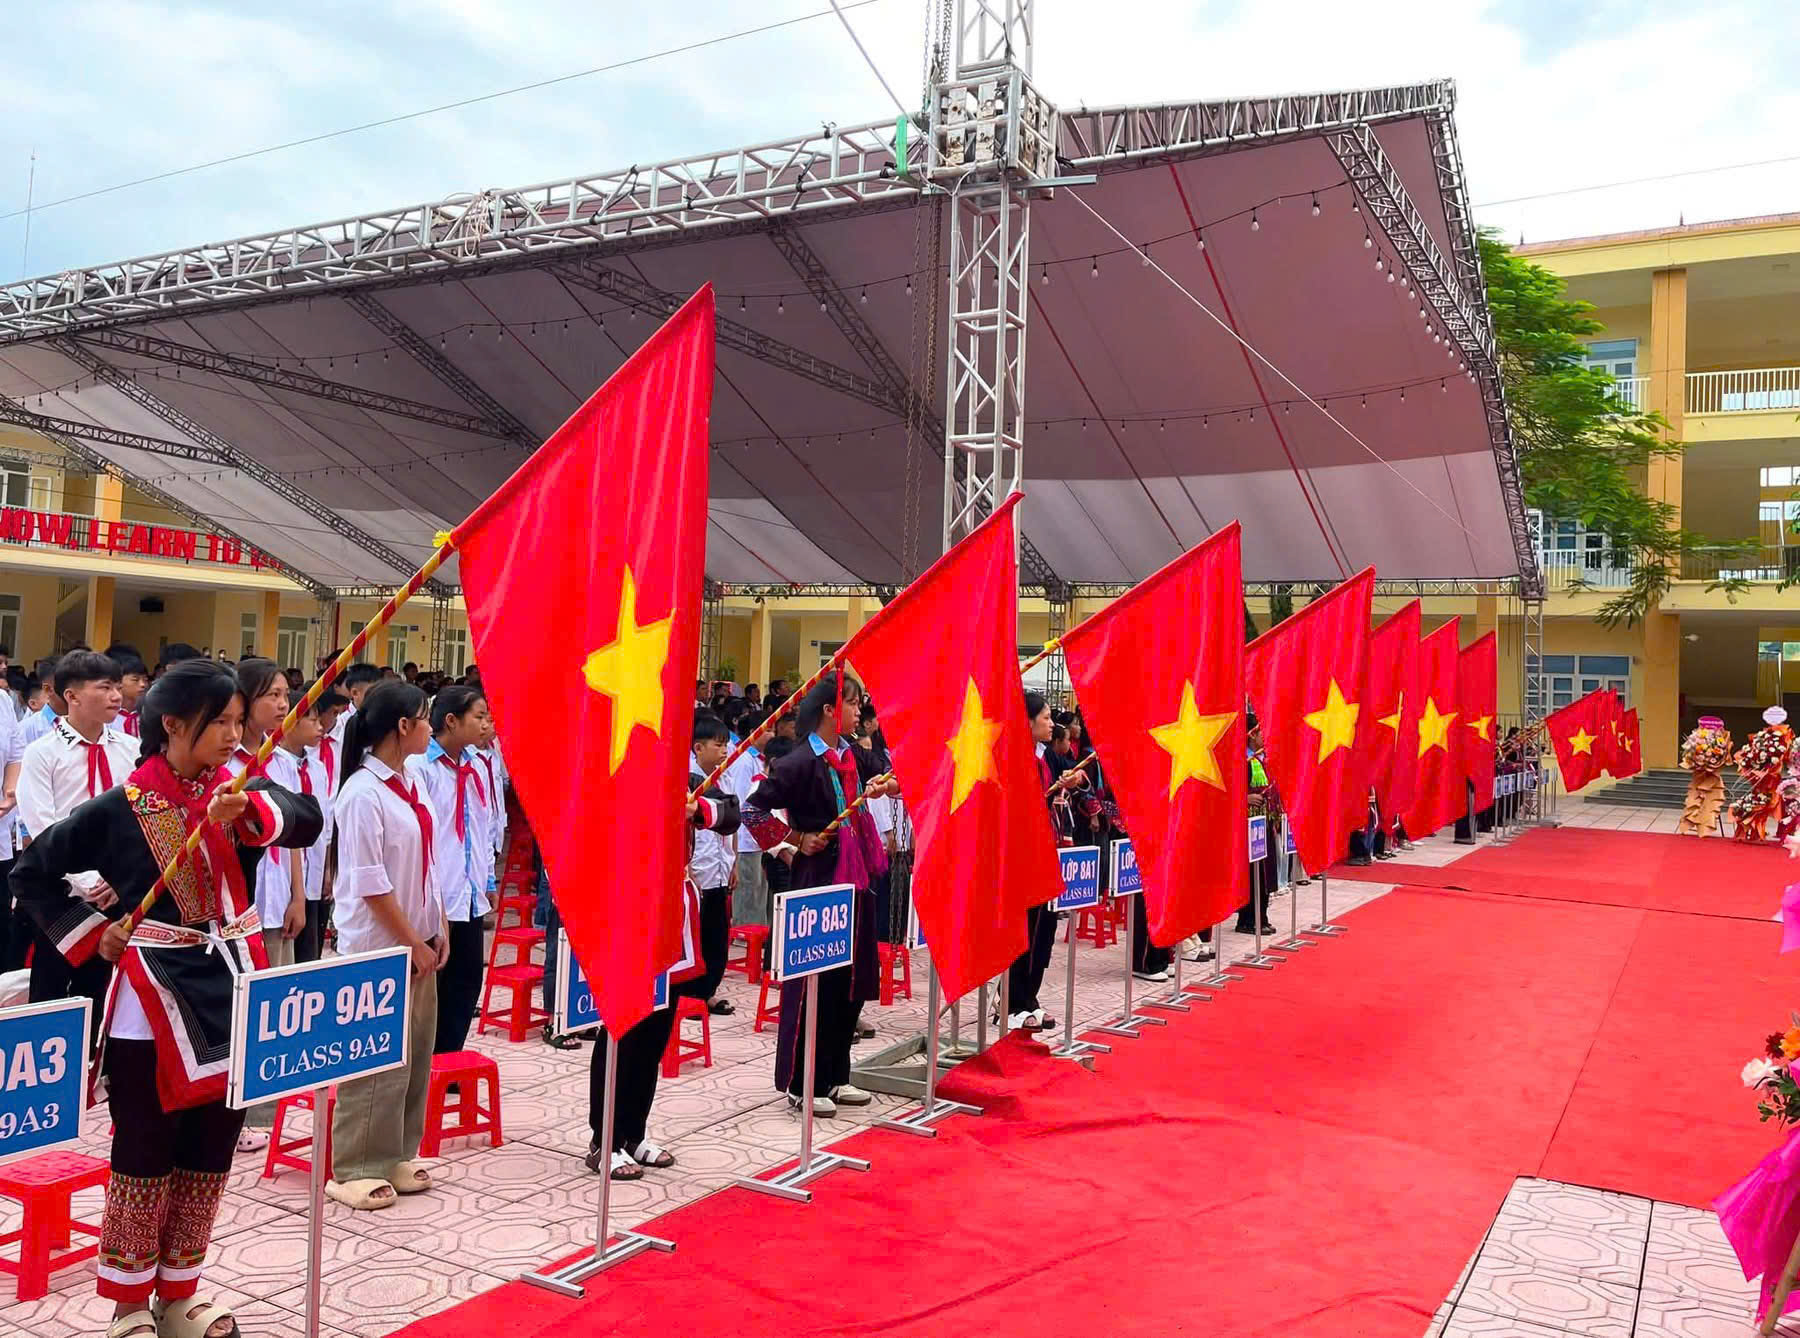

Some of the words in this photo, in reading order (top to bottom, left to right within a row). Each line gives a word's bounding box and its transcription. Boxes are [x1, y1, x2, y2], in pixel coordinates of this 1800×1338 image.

[88, 519, 197, 560] LEARN
[206, 534, 242, 565] TO
[1062, 858, 1079, 882] LỚP
[1080, 860, 1096, 880] 8A1
[1120, 848, 1136, 870] LỚP
[1120, 874, 1138, 888] CLASS
[789, 904, 818, 940] LỚP
[821, 903, 848, 934] 8A3
[789, 944, 825, 966] CLASS
[827, 939, 846, 958] 8A3
[258, 986, 325, 1042] LỚP
[335, 977, 397, 1026] 9A2
[0, 1036, 67, 1093] A3
[259, 1041, 343, 1082] CLASS
[348, 1031, 391, 1061] 9A2
[0, 1102, 60, 1140] 9A3
